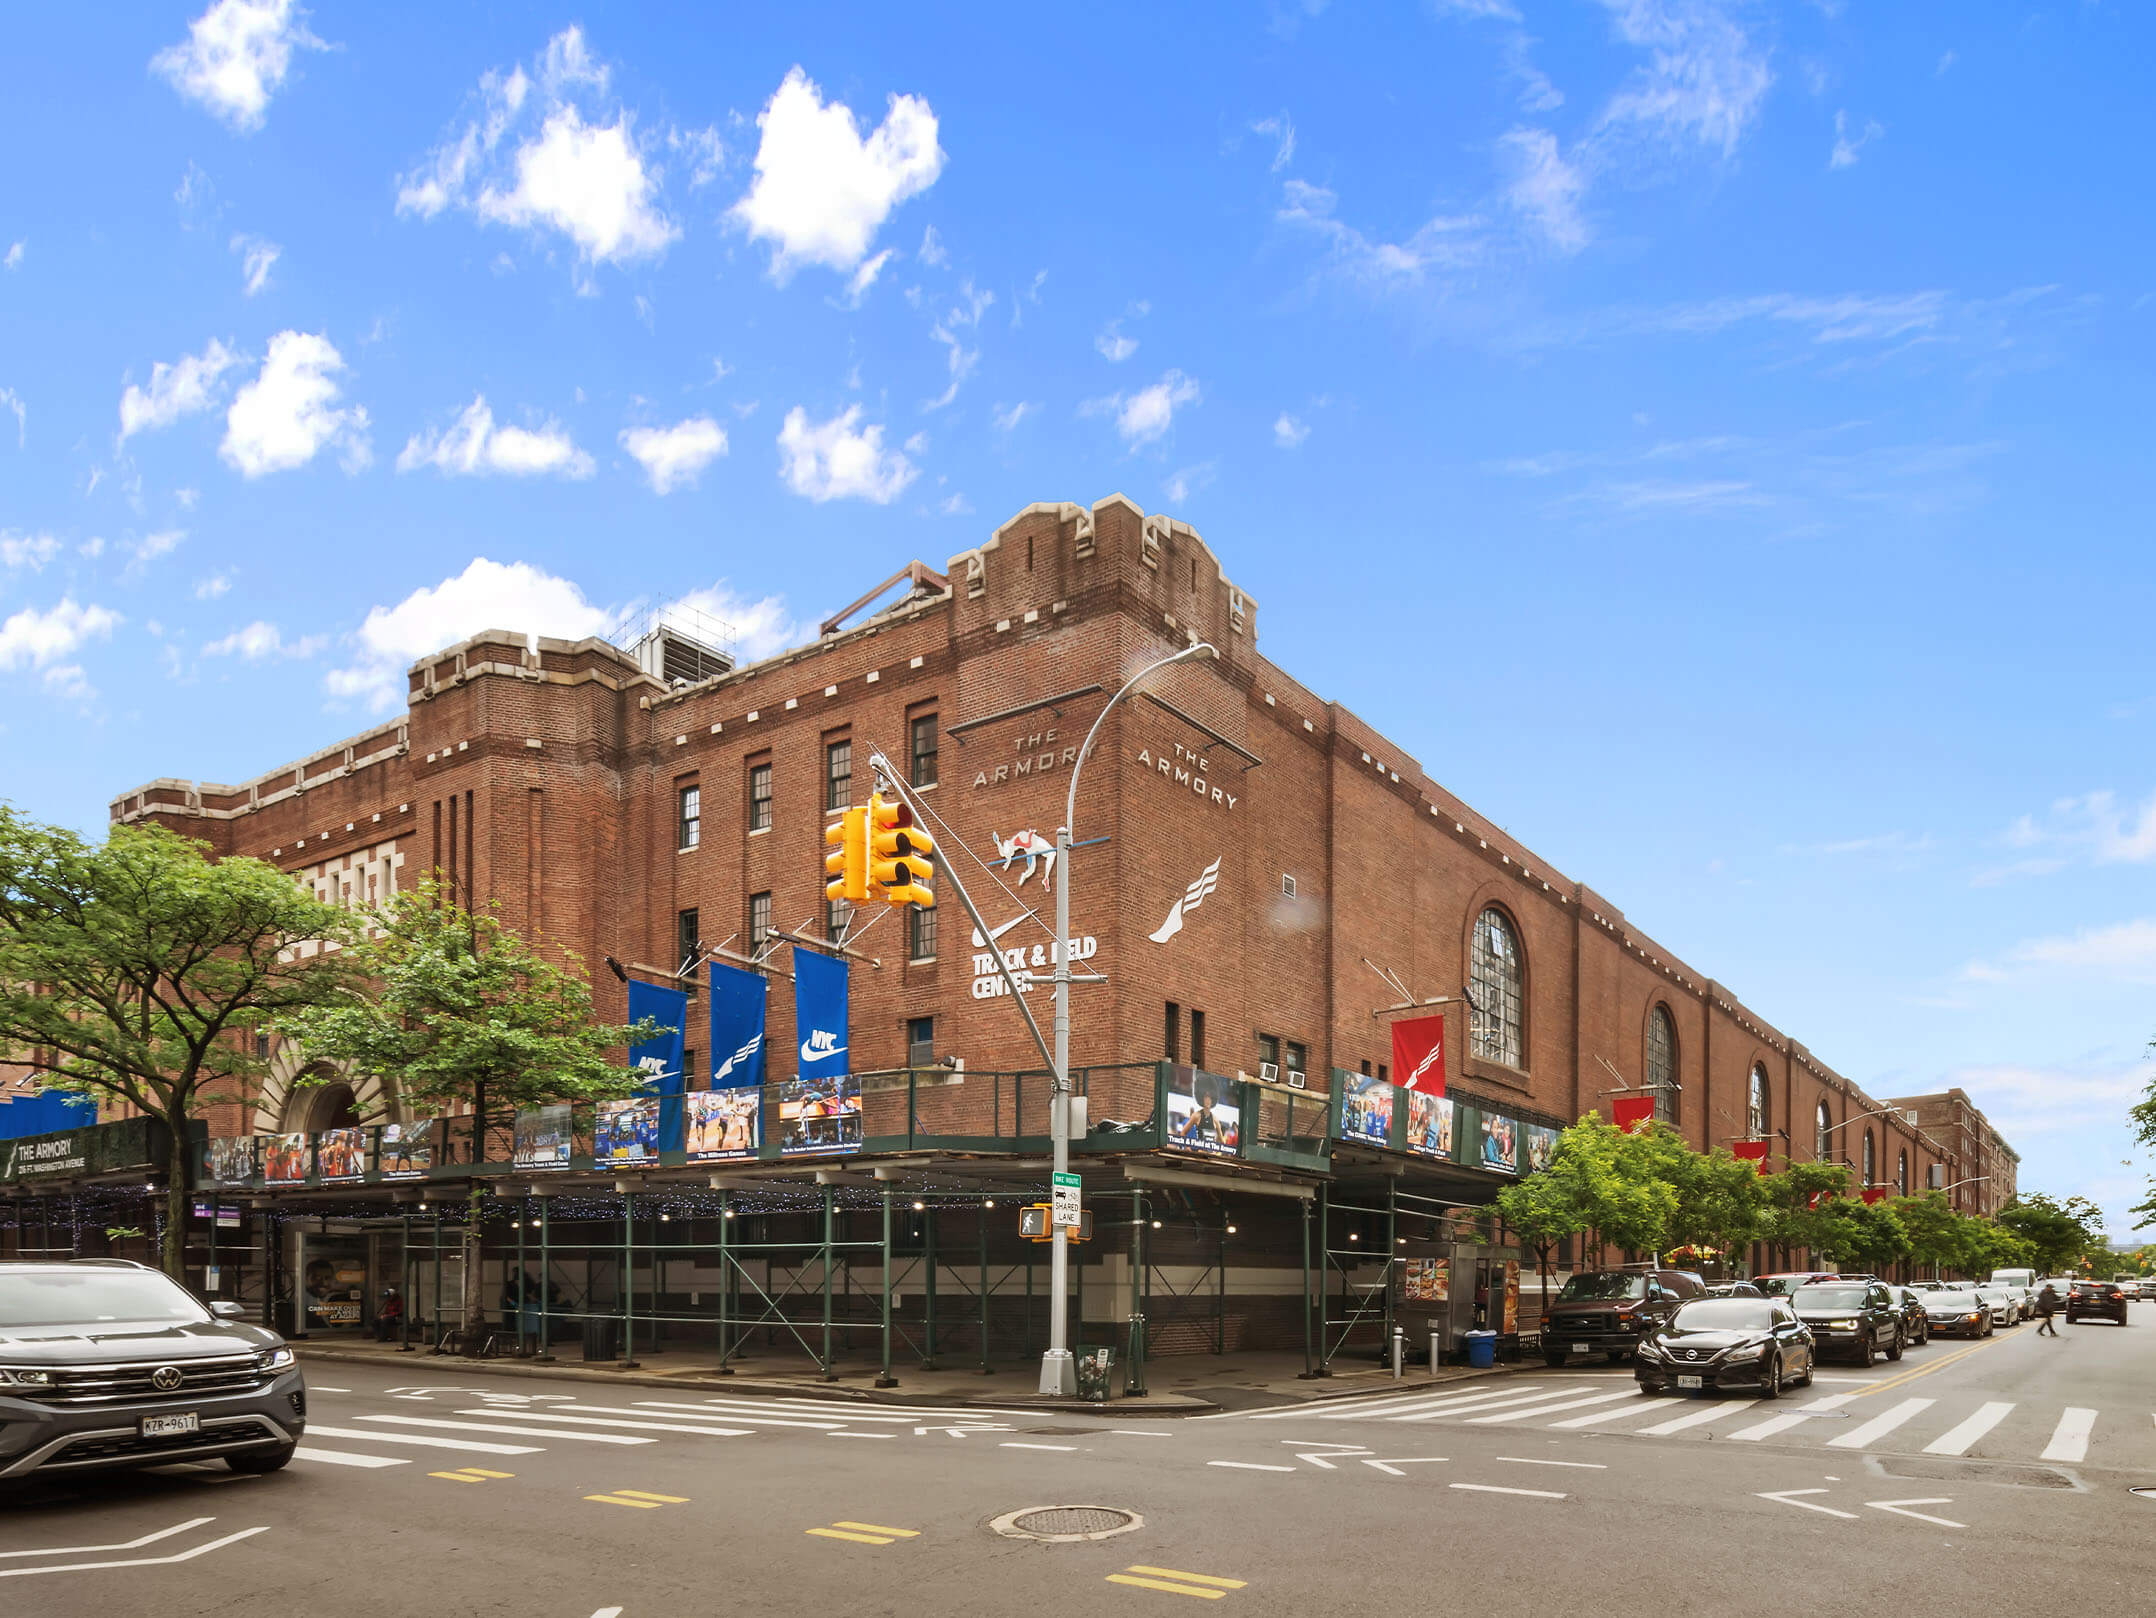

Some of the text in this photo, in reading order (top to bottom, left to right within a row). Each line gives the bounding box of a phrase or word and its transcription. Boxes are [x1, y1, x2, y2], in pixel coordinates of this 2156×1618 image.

[1015, 728, 1057, 751] THE
[973, 739, 1098, 789] ARMORY
[1174, 743, 1209, 772] THE
[1138, 749, 1238, 811] ARMORY
[1031, 944, 1047, 967] &
[811, 1029, 838, 1051] NYC
[18, 1138, 72, 1161] THE ARMORY
[1055, 1201, 1079, 1212] SHARED
[1058, 1213, 1075, 1222] LANE
